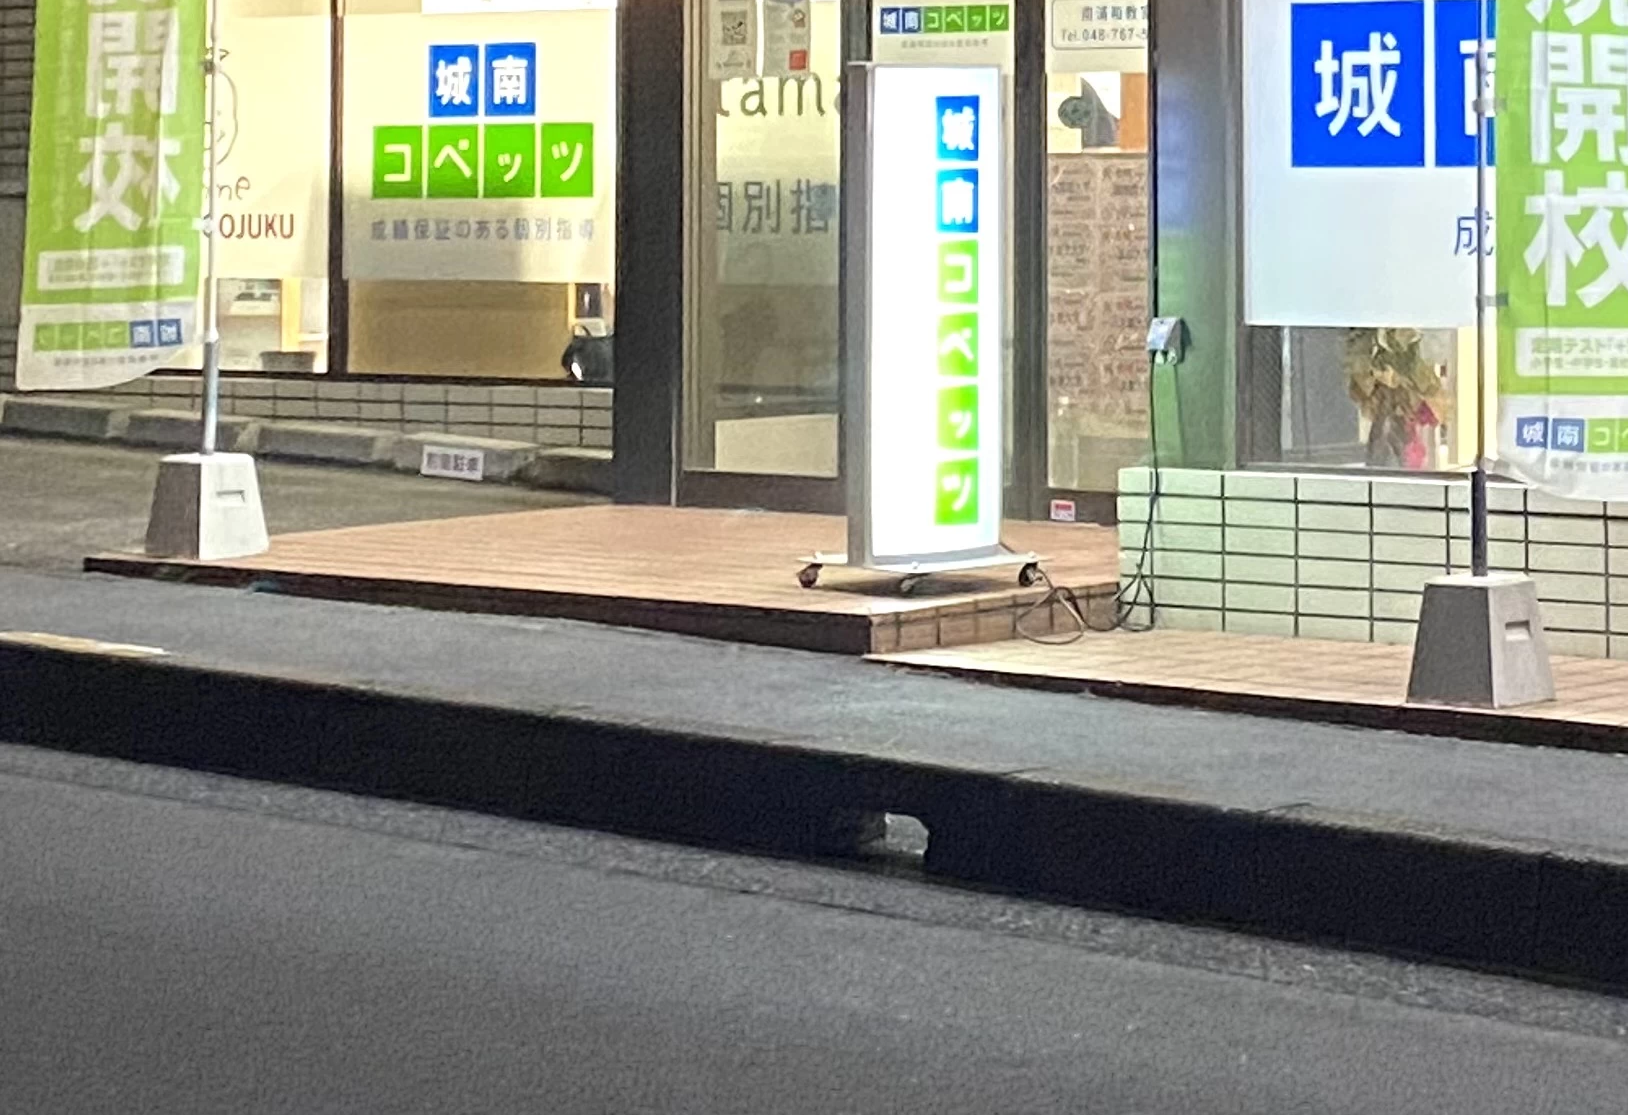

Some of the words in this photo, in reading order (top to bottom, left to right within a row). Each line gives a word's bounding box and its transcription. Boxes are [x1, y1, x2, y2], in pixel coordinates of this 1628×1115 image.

[435, 54, 528, 105] 城南
[384, 138, 583, 182] コベッツ
